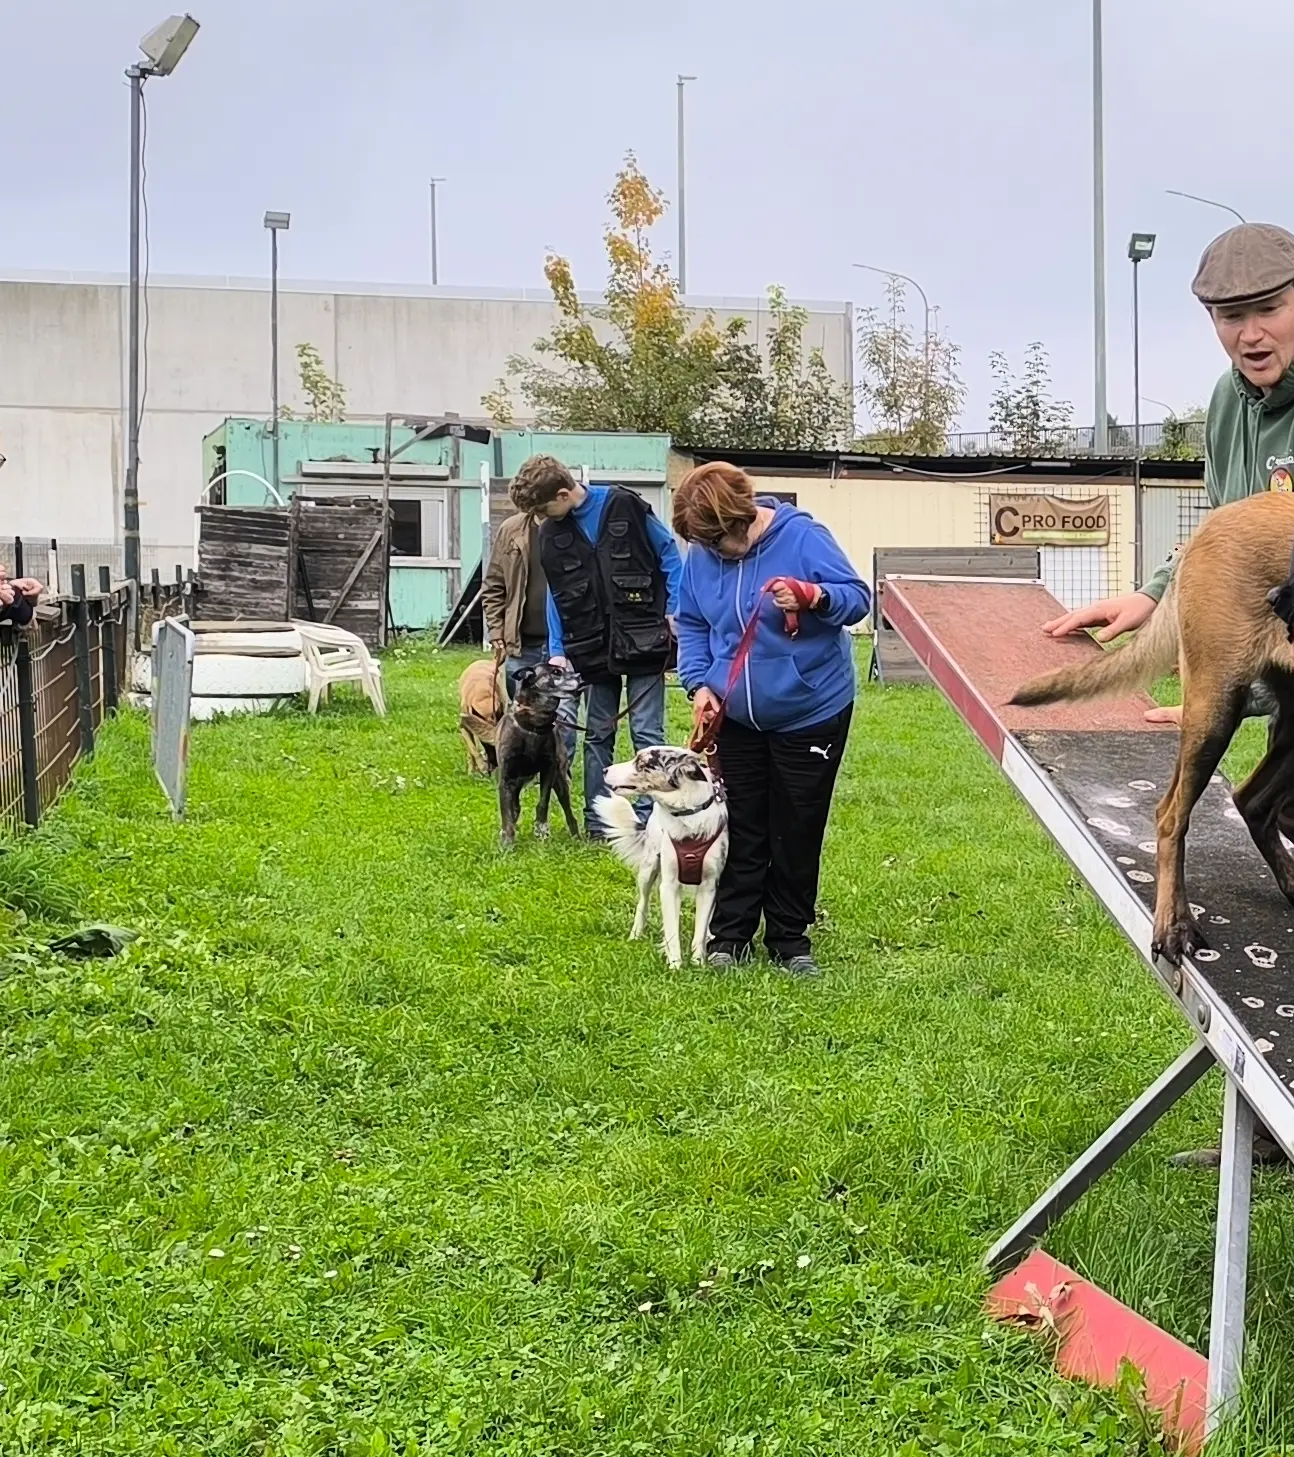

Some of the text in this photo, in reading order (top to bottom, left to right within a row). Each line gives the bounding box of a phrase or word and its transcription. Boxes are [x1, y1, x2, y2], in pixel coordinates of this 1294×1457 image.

[995, 506, 1107, 537] C PRO FOOD
